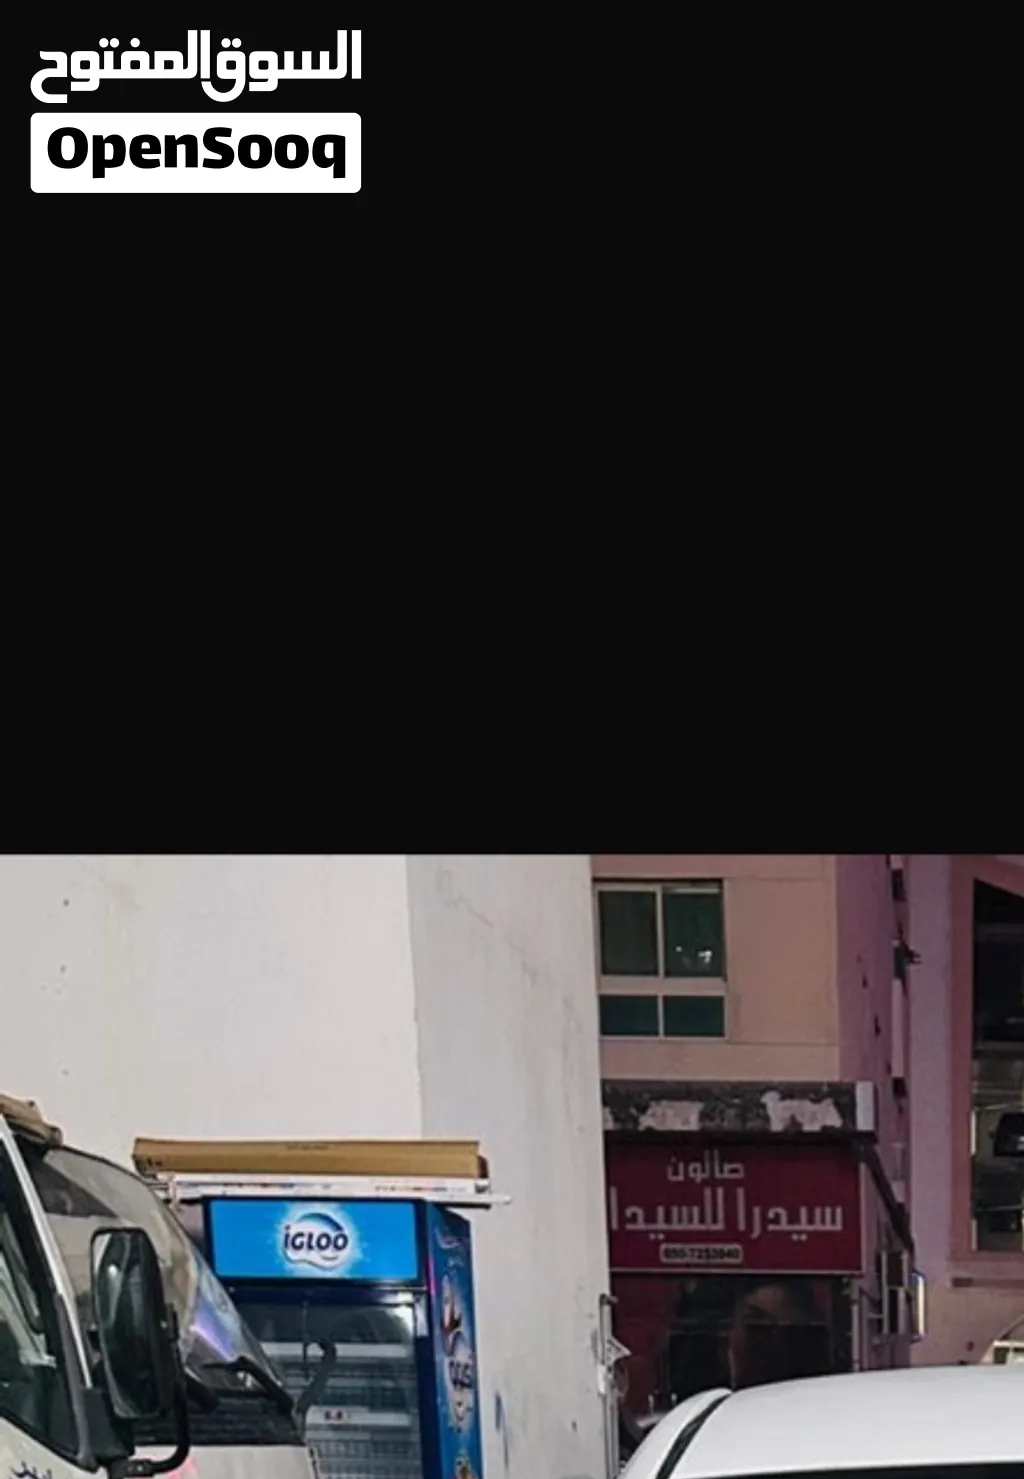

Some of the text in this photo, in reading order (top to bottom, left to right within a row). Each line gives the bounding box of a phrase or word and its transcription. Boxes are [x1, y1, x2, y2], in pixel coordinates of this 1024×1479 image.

[666, 1149, 745, 1182] صالون
[609, 1187, 843, 1241] سيدرا للسيدا
